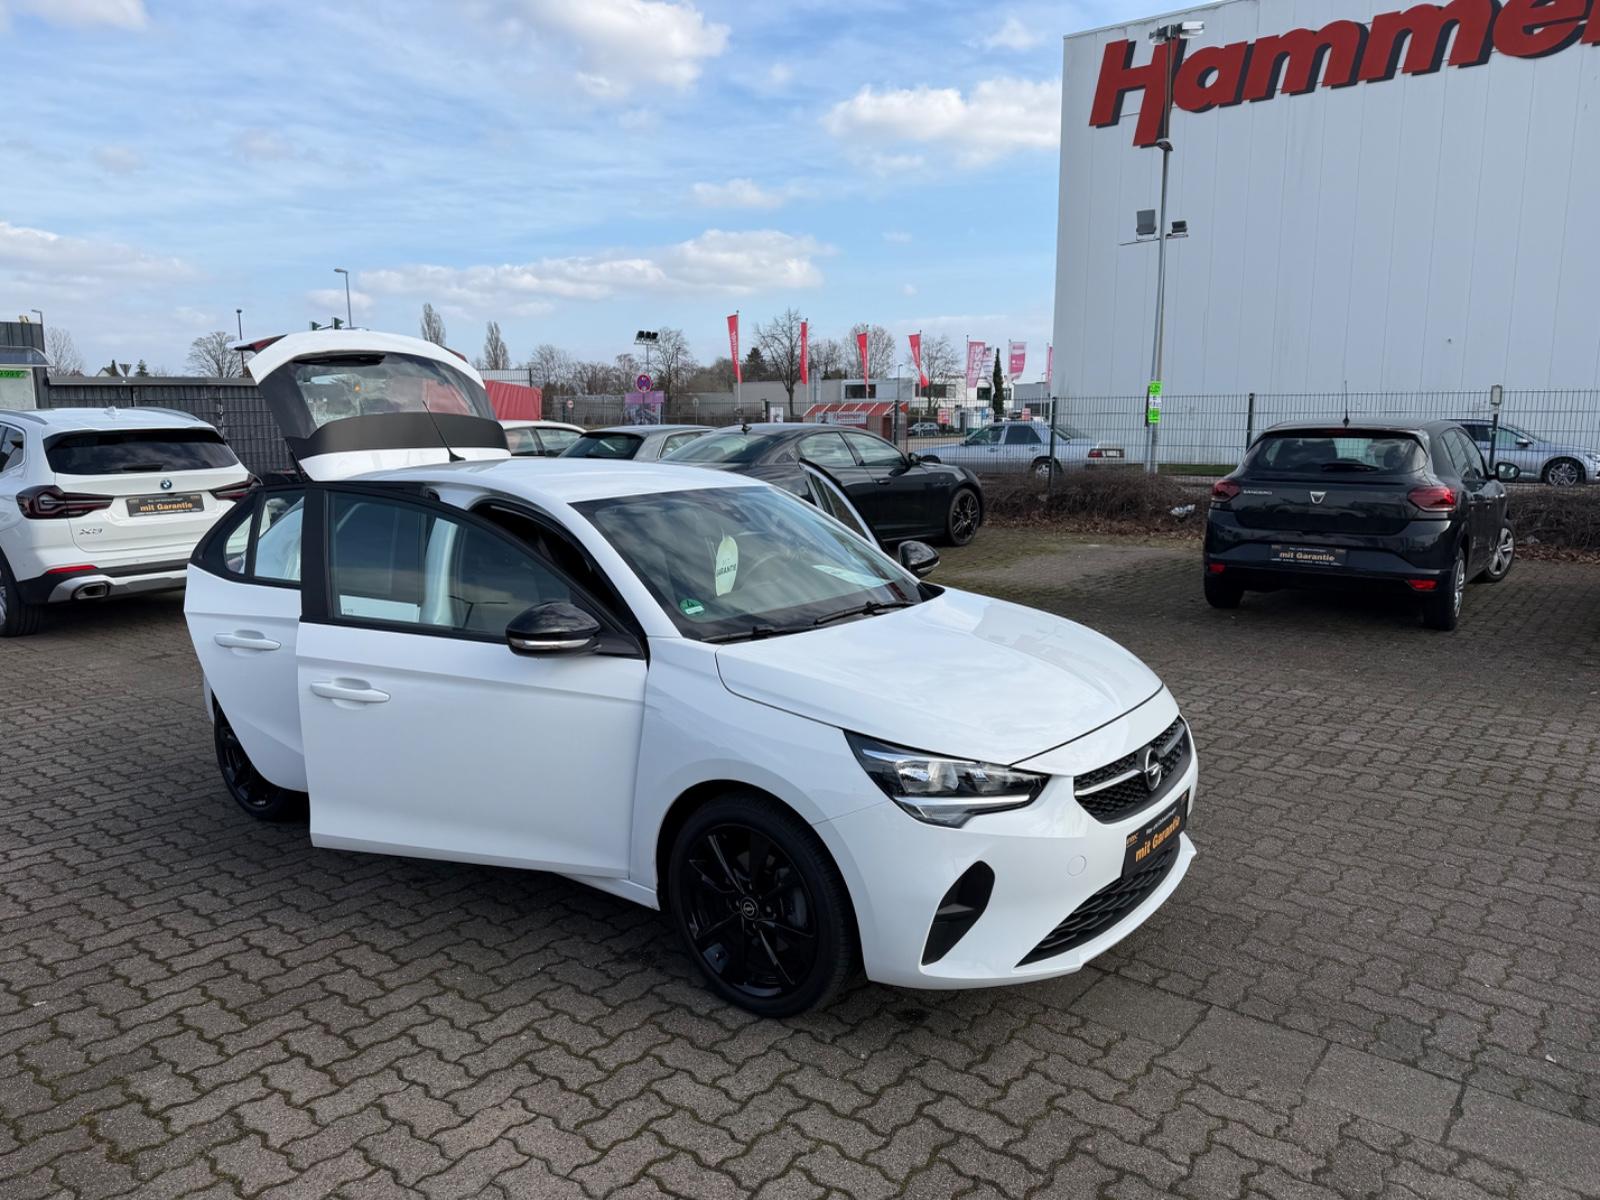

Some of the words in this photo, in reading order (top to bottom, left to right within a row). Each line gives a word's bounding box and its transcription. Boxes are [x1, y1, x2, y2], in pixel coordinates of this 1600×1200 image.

[140, 503, 155, 512] mit
[157, 501, 193, 511] Garantie
[1279, 551, 1294, 559] mit
[1296, 551, 1335, 561] Garantie
[1135, 840, 1152, 863] mit
[1152, 815, 1181, 849] Garantie
